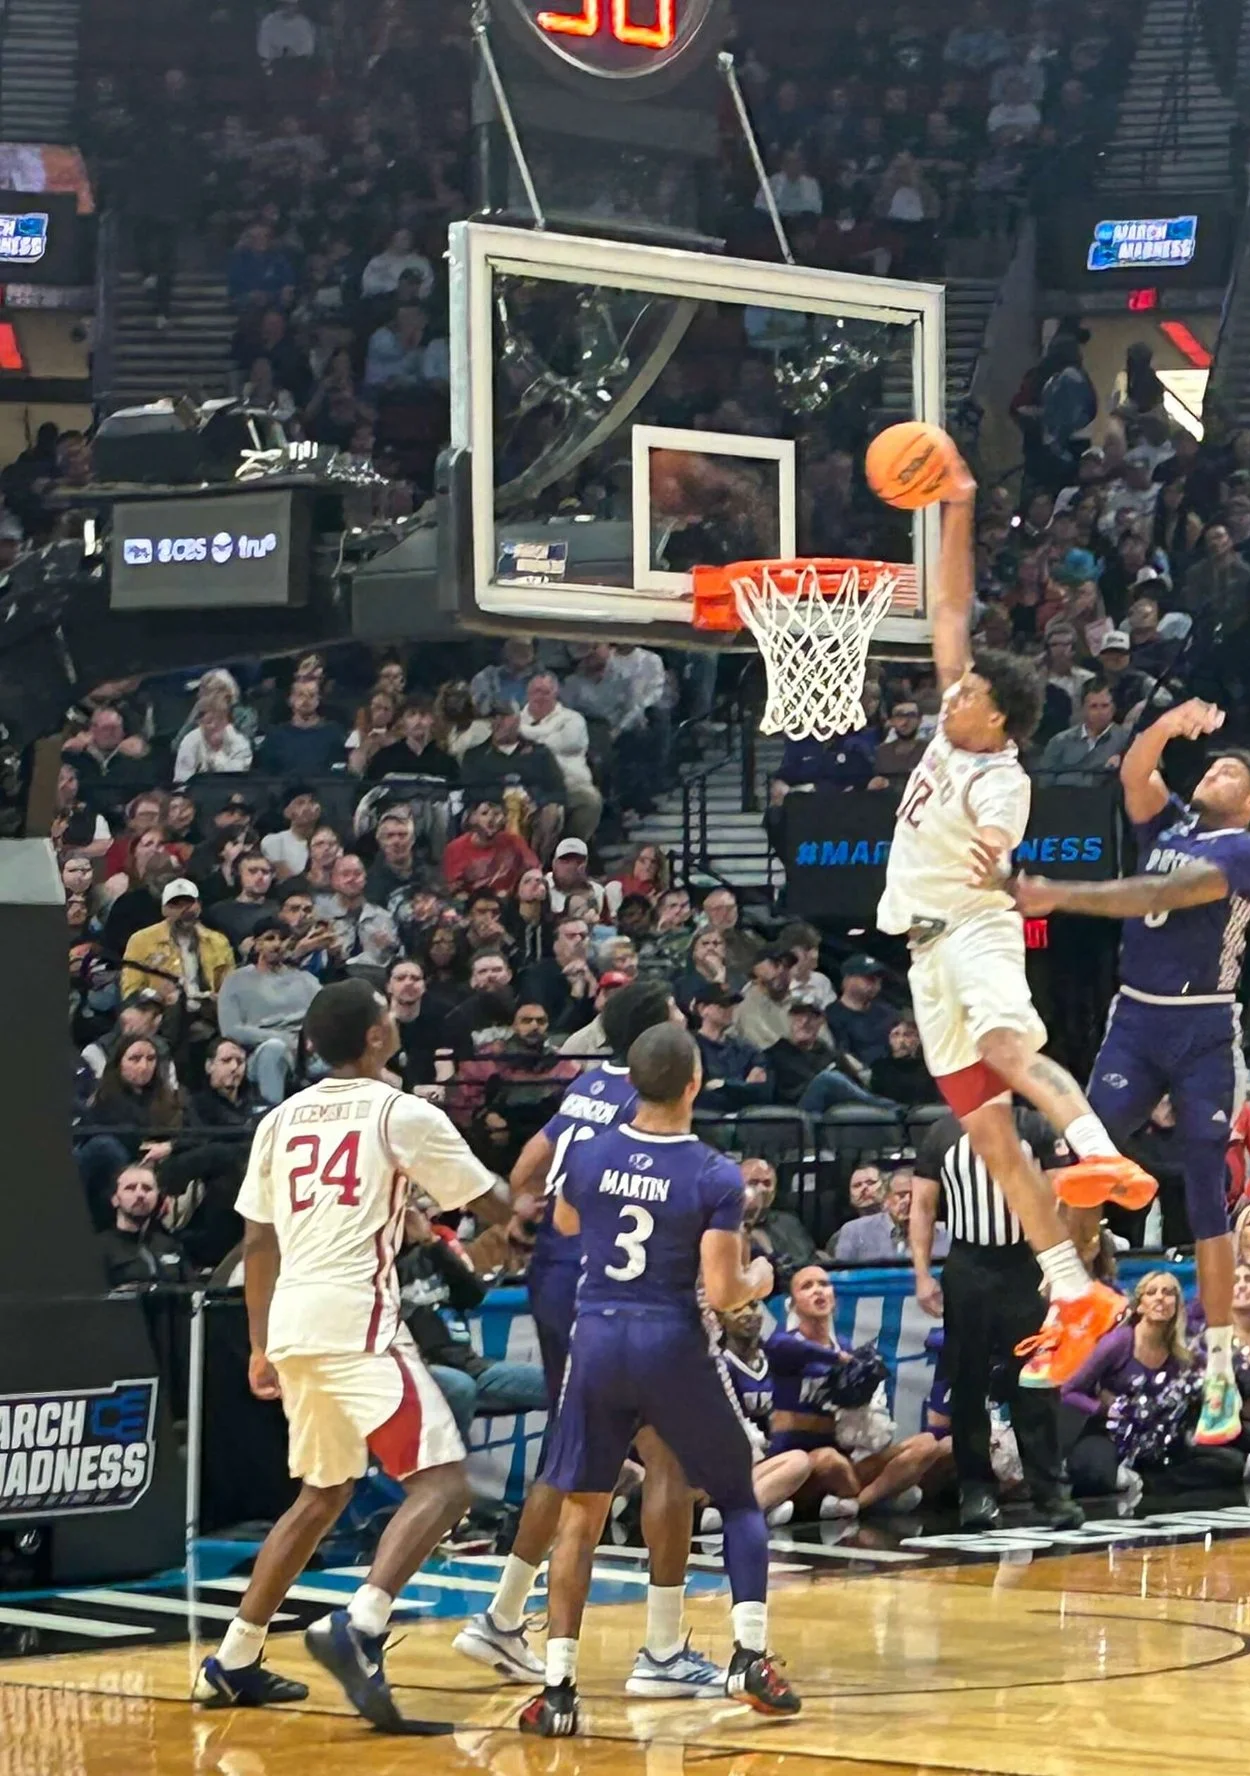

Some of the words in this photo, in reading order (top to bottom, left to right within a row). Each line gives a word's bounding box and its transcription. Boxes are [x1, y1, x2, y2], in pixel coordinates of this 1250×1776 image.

[286, 1130, 362, 1213] 24
[599, 1168, 671, 1202] MARTIN
[604, 1204, 655, 1282] 3
[0, 1442, 148, 1498] ADNESS
